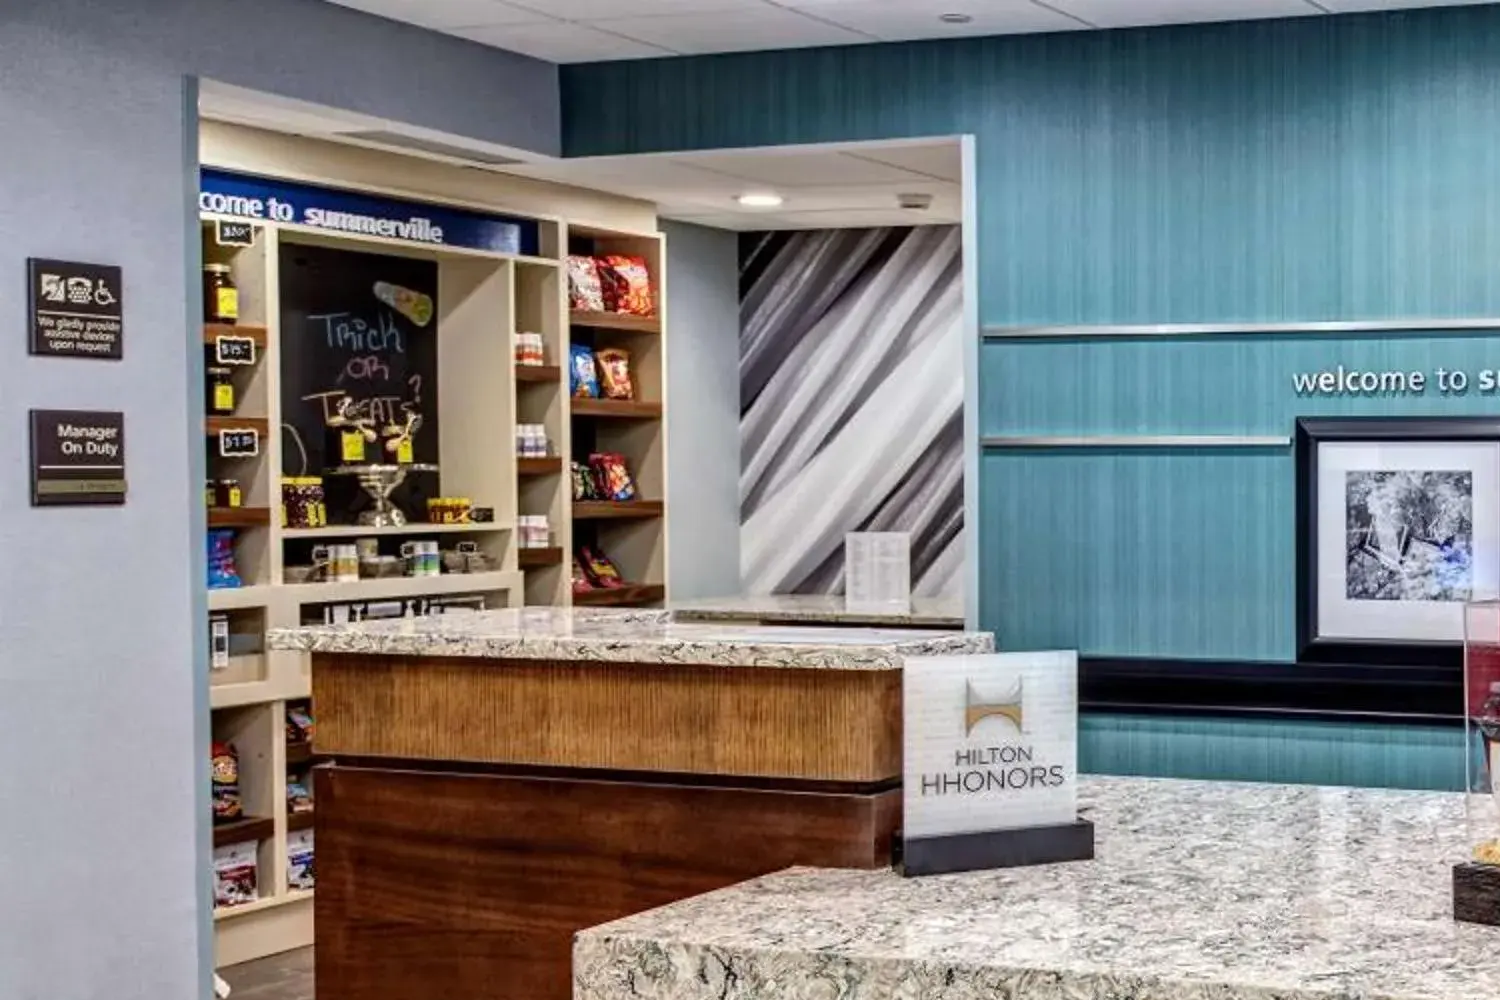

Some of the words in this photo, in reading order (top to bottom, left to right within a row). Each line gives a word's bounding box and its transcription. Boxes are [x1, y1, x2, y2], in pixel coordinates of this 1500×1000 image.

[267, 197, 294, 222] to
[304, 207, 443, 243] summerville
[86, 320, 120, 332] provide
[49, 340, 74, 351] upon
[1292, 365, 1425, 393] welcome
[1437, 367, 1468, 391] to
[57, 423, 118, 441] Manager
[61, 441, 82, 454] On
[86, 441, 118, 457] Duty
[955, 745, 1033, 766] HILTON
[921, 765, 1065, 796] HHONORS
